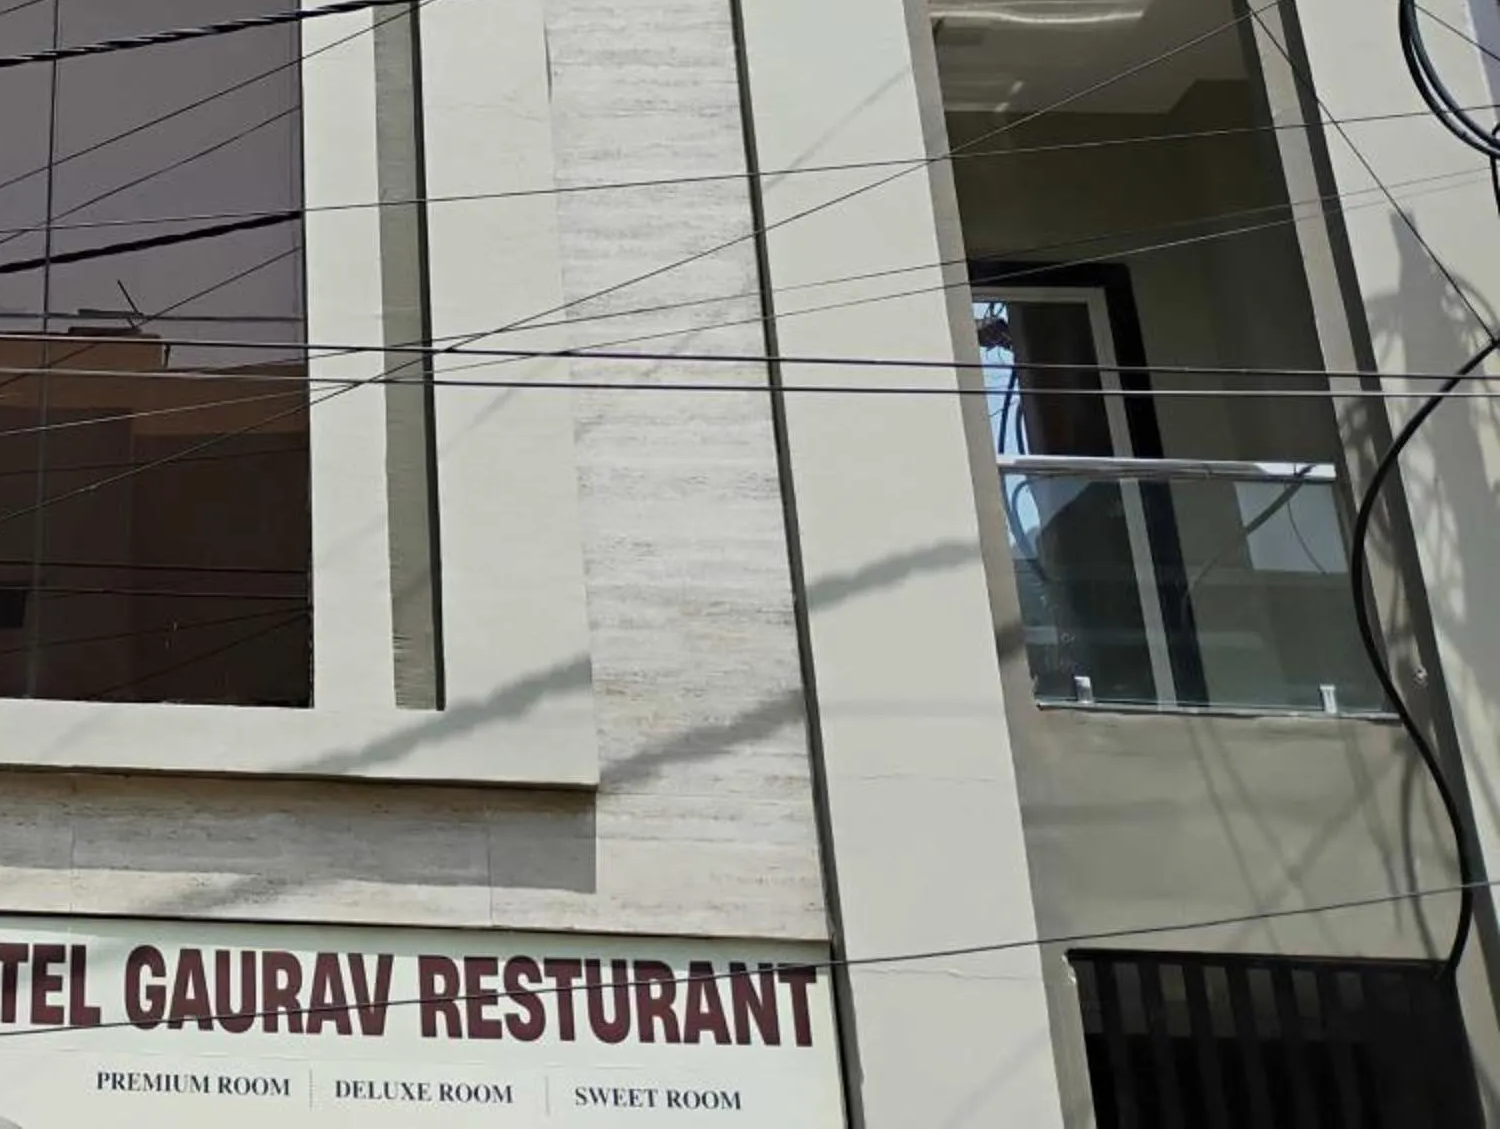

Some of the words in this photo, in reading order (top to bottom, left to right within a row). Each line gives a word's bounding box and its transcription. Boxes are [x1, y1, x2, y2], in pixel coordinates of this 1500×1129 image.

[124, 944, 394, 1036] GAURAV
[418, 955, 817, 1047] RESTURANT
[97, 1071, 210, 1094] PREMIUM
[217, 1075, 291, 1097] ROOM
[335, 1079, 432, 1101] DELUXE
[439, 1082, 514, 1105] ROOM
[575, 1086, 658, 1108] SWEET
[666, 1089, 742, 1111] ROOM
